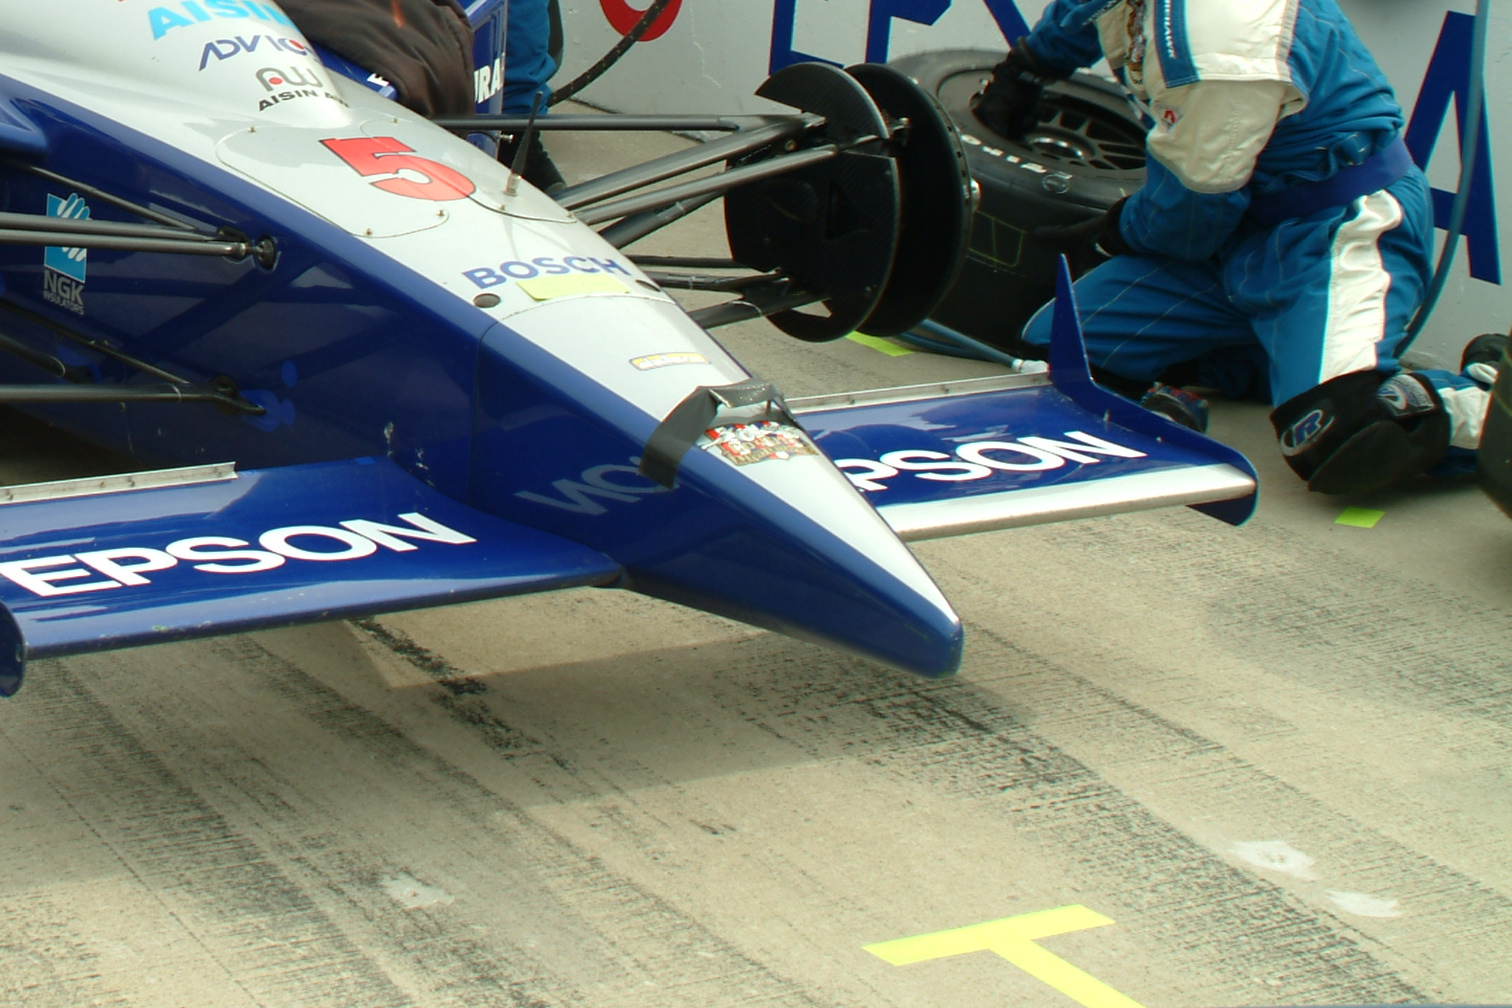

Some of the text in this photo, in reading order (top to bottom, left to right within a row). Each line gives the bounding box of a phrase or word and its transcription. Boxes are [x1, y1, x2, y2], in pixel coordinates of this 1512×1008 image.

[259, 89, 316, 112] AISIN
[319, 135, 477, 202] 5
[43, 268, 84, 306] NGK
[461, 255, 632, 290] BOSCH
[835, 430, 1148, 493] PSON
